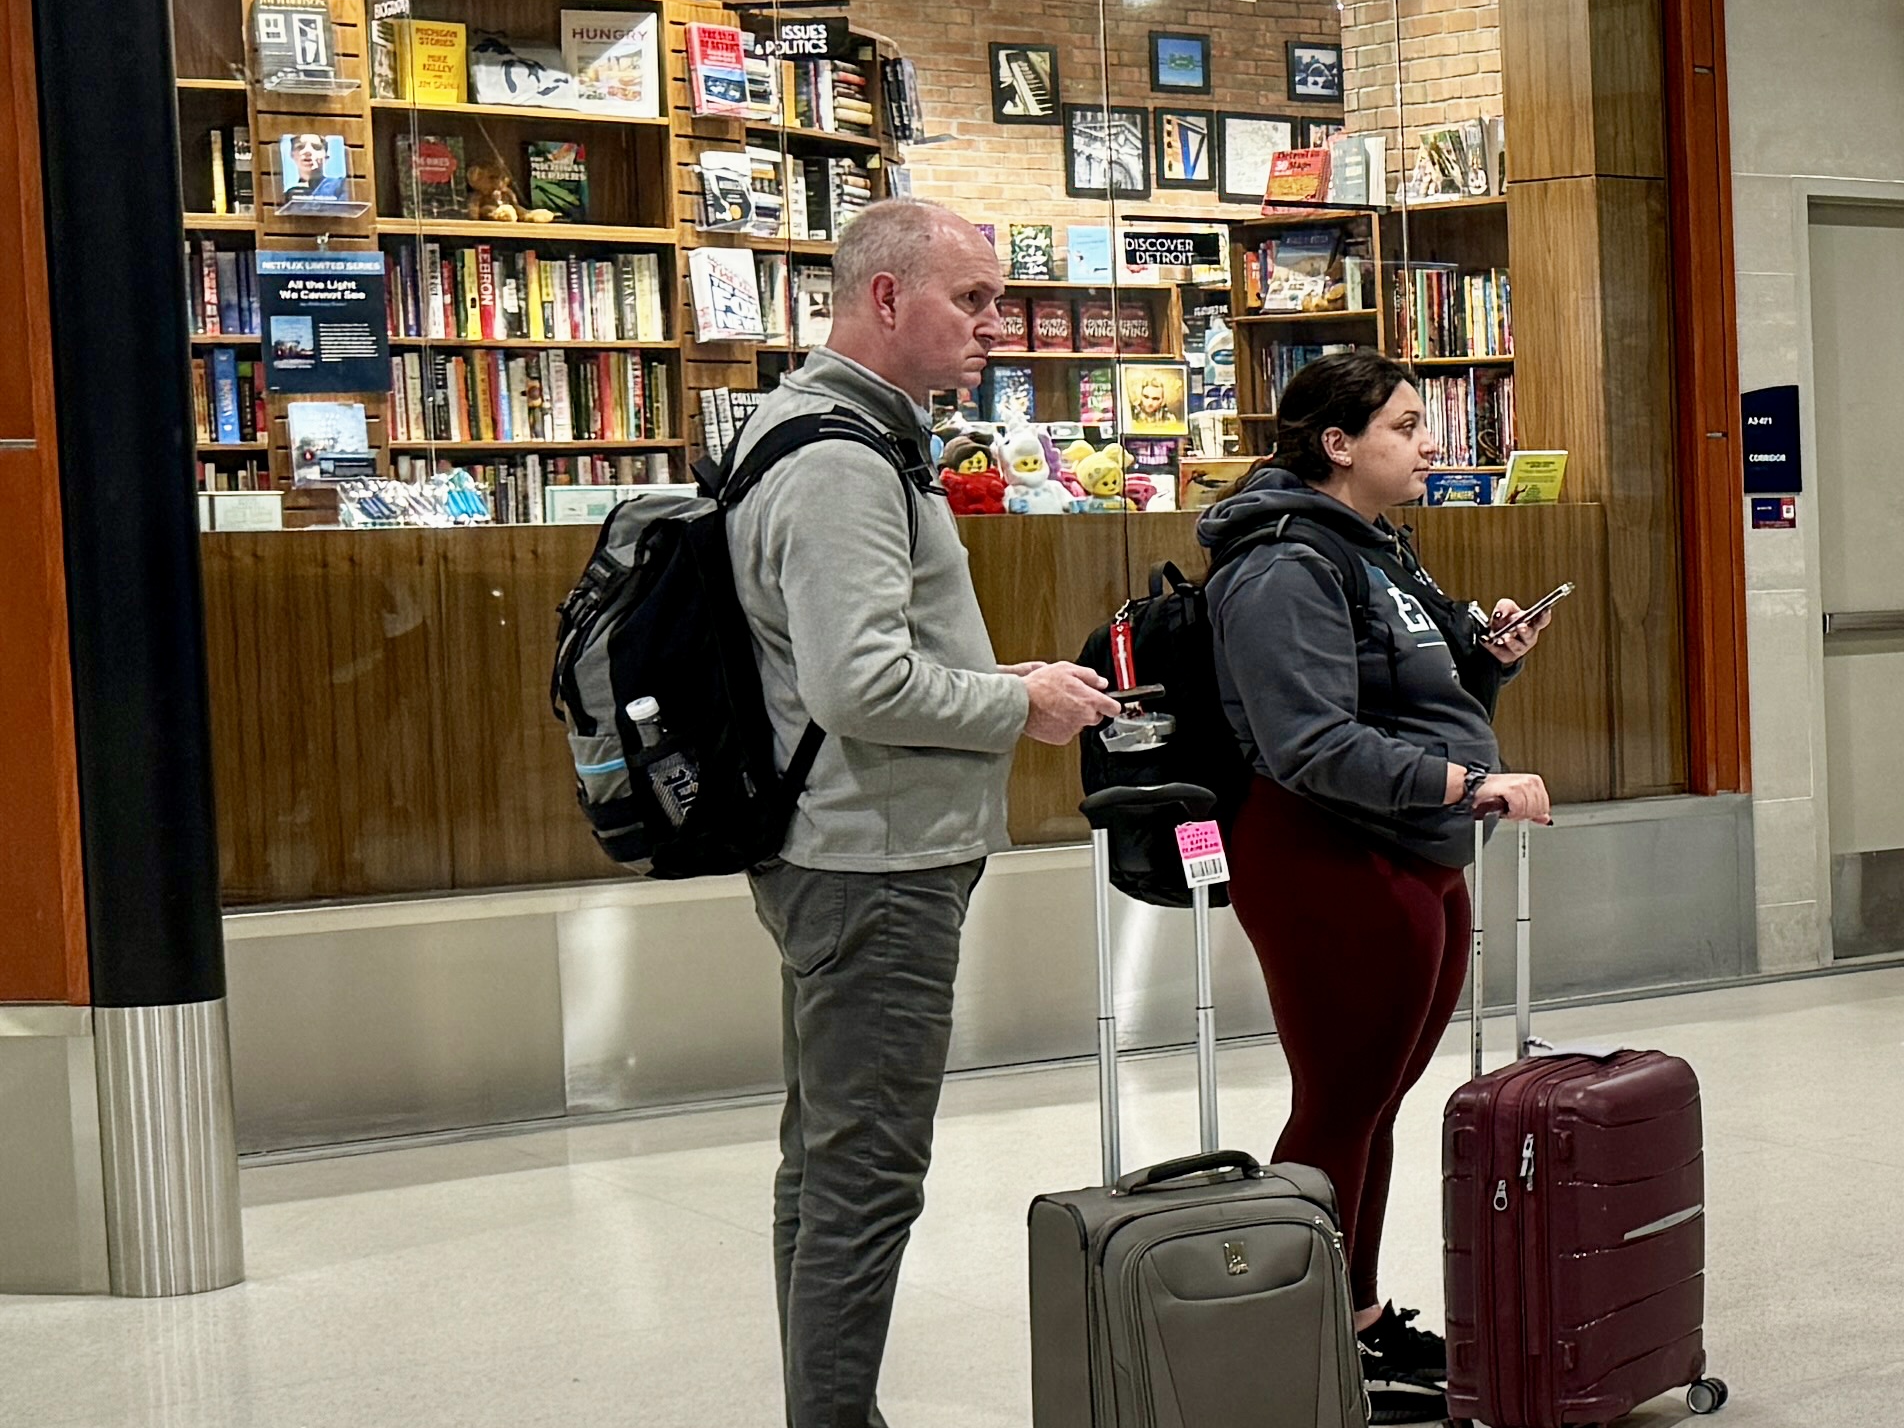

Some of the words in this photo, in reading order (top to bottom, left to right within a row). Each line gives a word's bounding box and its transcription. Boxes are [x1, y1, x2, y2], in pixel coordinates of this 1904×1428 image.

[572, 28, 648, 40] HUNGRY
[782, 24, 827, 40] ISSUES
[765, 40, 828, 54] POLITICS
[1126, 238, 1194, 252] DISCOVER
[1136, 252, 1195, 264] DETROIT
[477, 245, 494, 307] LEBRON
[288, 280, 303, 289] All
[306, 280, 324, 289] the
[327, 280, 356, 290] Light
[280, 291, 298, 299] We
[300, 291, 341, 300] Cannot
[344, 291, 366, 299] See
[1038, 324, 1067, 337] WING
[1084, 325, 1115, 337] WING
[1120, 325, 1149, 338] WING
[1749, 454, 1786, 462] CORRIDOR
